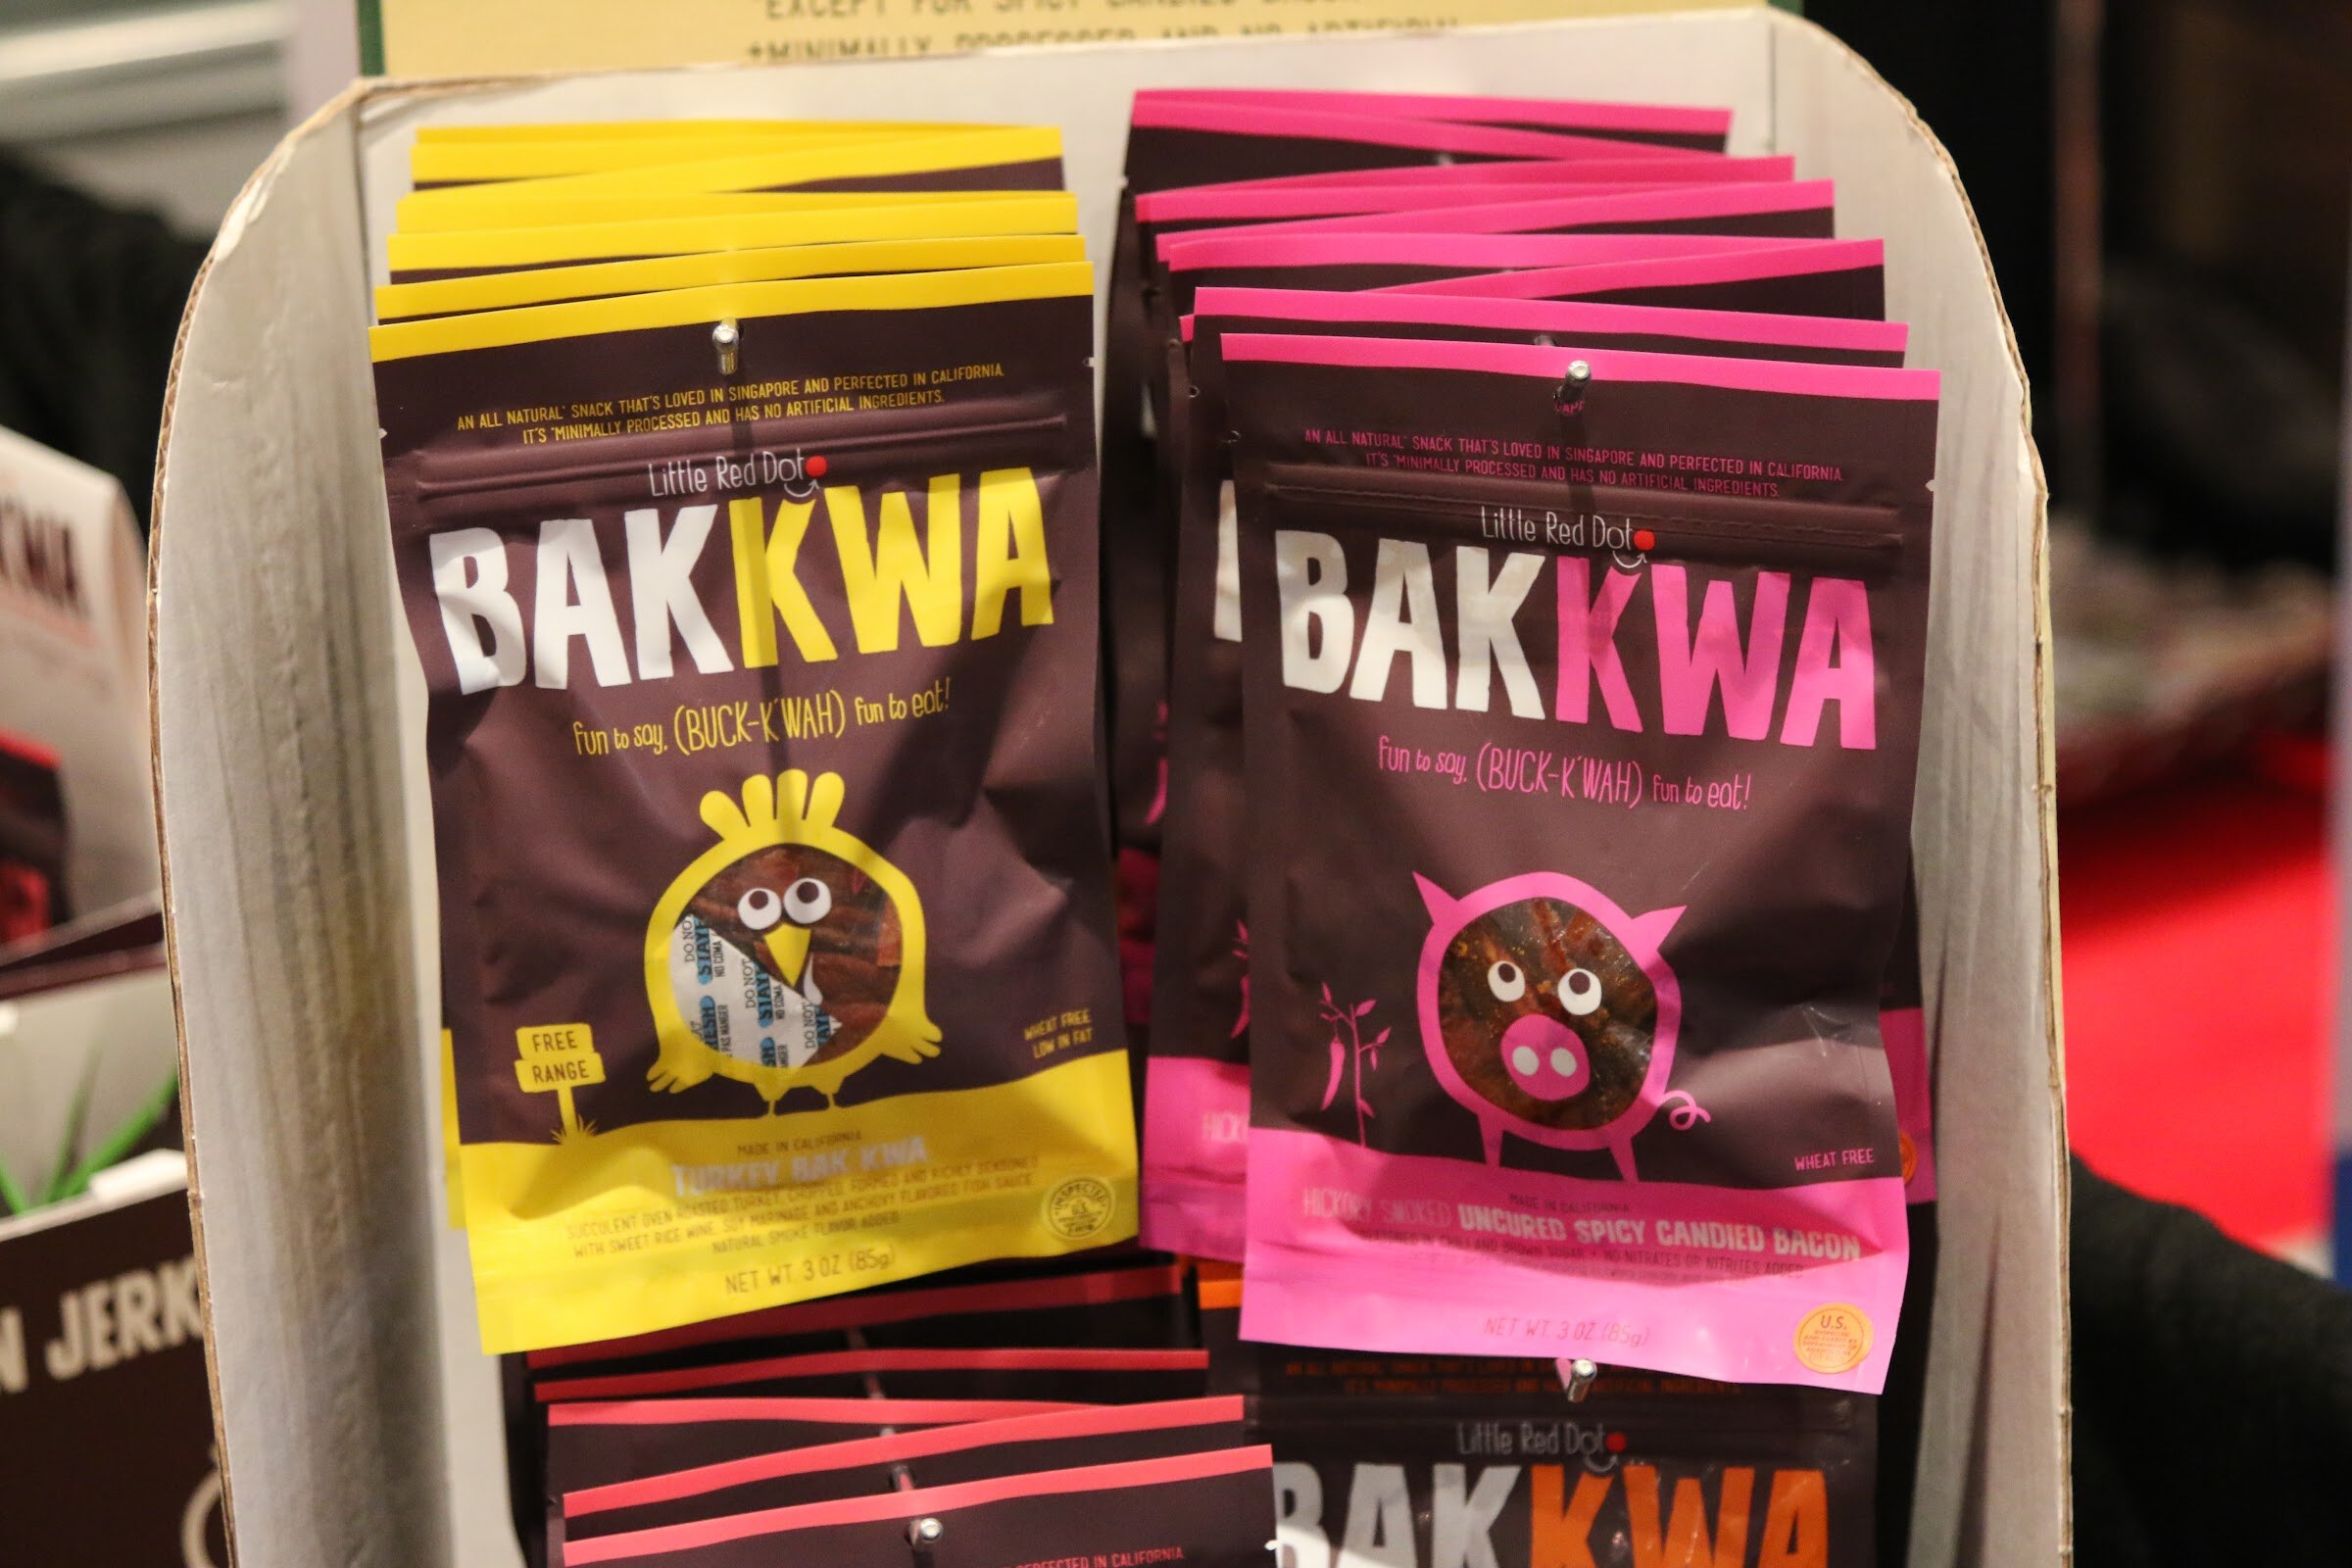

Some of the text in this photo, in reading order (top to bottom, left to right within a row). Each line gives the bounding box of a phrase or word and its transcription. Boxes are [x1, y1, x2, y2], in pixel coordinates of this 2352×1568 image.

[458, 416, 473, 431] AN
[479, 413, 502, 428] ALL
[571, 401, 612, 418] SNACK
[618, 394, 661, 414] THAT'S
[664, 389, 705, 408] LOVED
[710, 387, 724, 403] IN
[729, 379, 799, 402] SINGAPORE
[805, 377, 829, 394] AND
[834, 373, 907, 391] PERFECTED
[913, 371, 926, 385] IN
[522, 426, 547, 444] IT'S
[627, 413, 701, 433] PROCESSED
[706, 409, 730, 425] AND
[736, 405, 760, 421] HAS
[764, 403, 781, 418] NO
[786, 397, 854, 416] ARTIFICIAL
[859, 390, 944, 410] INGREDIENTS.
[648, 447, 805, 497] Little Red Dot
[1304, 429, 1321, 444] AN
[1326, 430, 1348, 445] ALL
[1412, 436, 1453, 452] SNACK
[1458, 437, 1499, 456] THAT'S
[1503, 442, 1542, 460] LOVED
[1547, 446, 1560, 461] IN
[1566, 447, 1635, 466] SINGAPORE
[1640, 453, 1665, 469] AND
[1670, 454, 1744, 474] PERFECTED
[1749, 462, 1762, 476] IN
[1365, 453, 1390, 467] IT'S
[1465, 460, 1537, 479] PROCESSED
[1541, 466, 1566, 481] AND
[1570, 467, 1593, 483] HAS
[1599, 470, 1616, 485] NO
[1621, 472, 1688, 490] ARTIFICIAL
[1693, 477, 1780, 498] INGREDIENTS.
[1481, 506, 1635, 551] Little Red Dot
[572, 720, 610, 756] fun
[613, 727, 629, 750] to
[855, 697, 885, 726] fun
[889, 693, 907, 720] to
[911, 676, 952, 718] eat!
[1378, 735, 1410, 771] fun
[1416, 748, 1431, 771] to
[1652, 774, 1680, 803] fun
[1685, 776, 1702, 806] to
[1707, 773, 1752, 810] eat!
[682, 916, 696, 962] DO NO
[697, 930, 712, 978] STAY
[712, 940, 726, 978] NO COMA
[742, 958, 757, 1009] DO NOT
[758, 974, 773, 1020] STAY
[532, 1031, 578, 1053] FREE
[801, 1003, 816, 1049] DO NOT
[1024, 1007, 1091, 1041] WHEAT FREE
[532, 1060, 589, 1084] RANGE
[672, 1159, 781, 1198] TURKEY
[792, 1150, 848, 1182] BAK
[860, 1136, 926, 1170] KWA
[1793, 1148, 1875, 1171] WHEAT FREE
[573, 1242, 605, 1258] WITH
[610, 1234, 650, 1254] SWEET
[655, 1227, 681, 1245] RICE
[1457, 1202, 1567, 1242] UNCURED
[1576, 1219, 1645, 1246] SPICY
[1656, 1219, 1765, 1252] CANDIED
[1774, 1227, 1861, 1260] BACON
[725, 1270, 760, 1294] NET
[804, 1260, 815, 1281] 3
[820, 1254, 841, 1278] OZ
[45, 1250, 204, 1381] JERK
[1485, 1317, 1517, 1337] NET
[1557, 1322, 1569, 1341] 3
[1574, 1322, 1596, 1341] OZ
[1821, 1314, 1847, 1330] U.S.
[1457, 1421, 1604, 1456] Little Red Dot
[1095, 1555, 1108, 1568] IN
